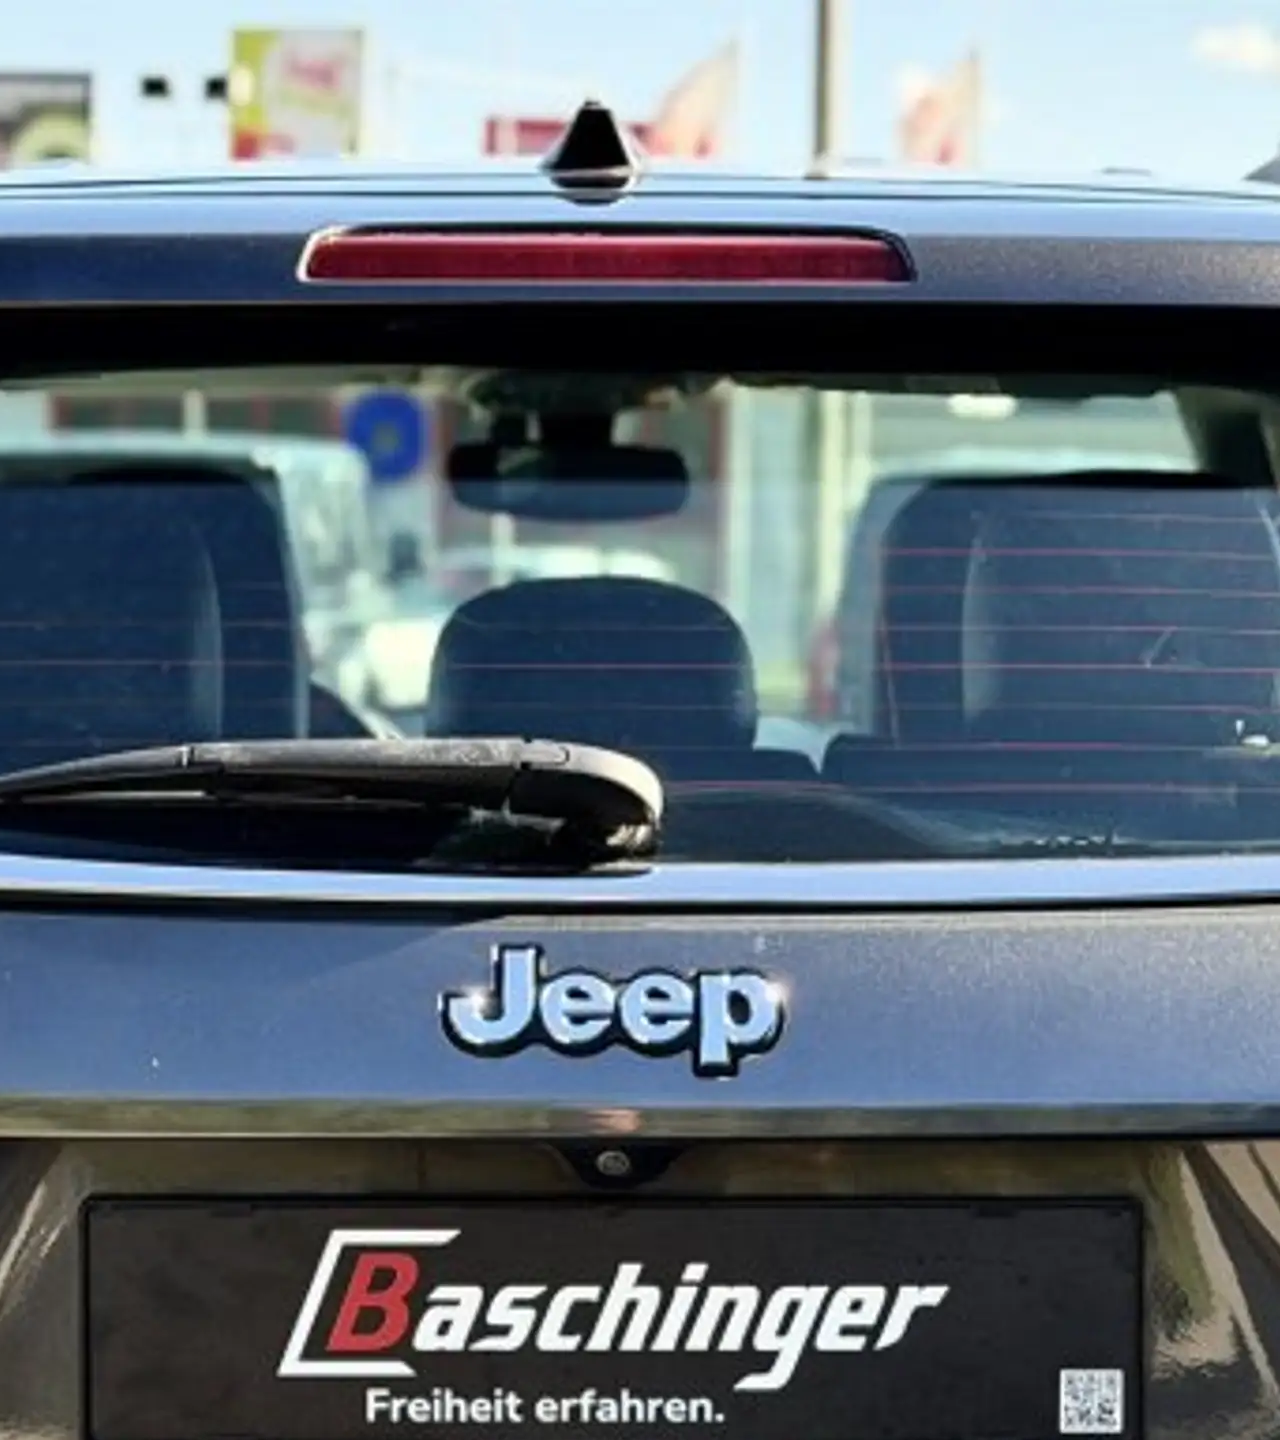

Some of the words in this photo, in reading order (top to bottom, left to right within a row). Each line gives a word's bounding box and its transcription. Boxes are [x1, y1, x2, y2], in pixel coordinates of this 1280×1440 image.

[438, 943, 788, 1078] Jeep
[323, 1250, 951, 1391] Baschinger
[365, 1388, 522, 1424] Freiheit
[534, 1388, 726, 1424] erfahren.
